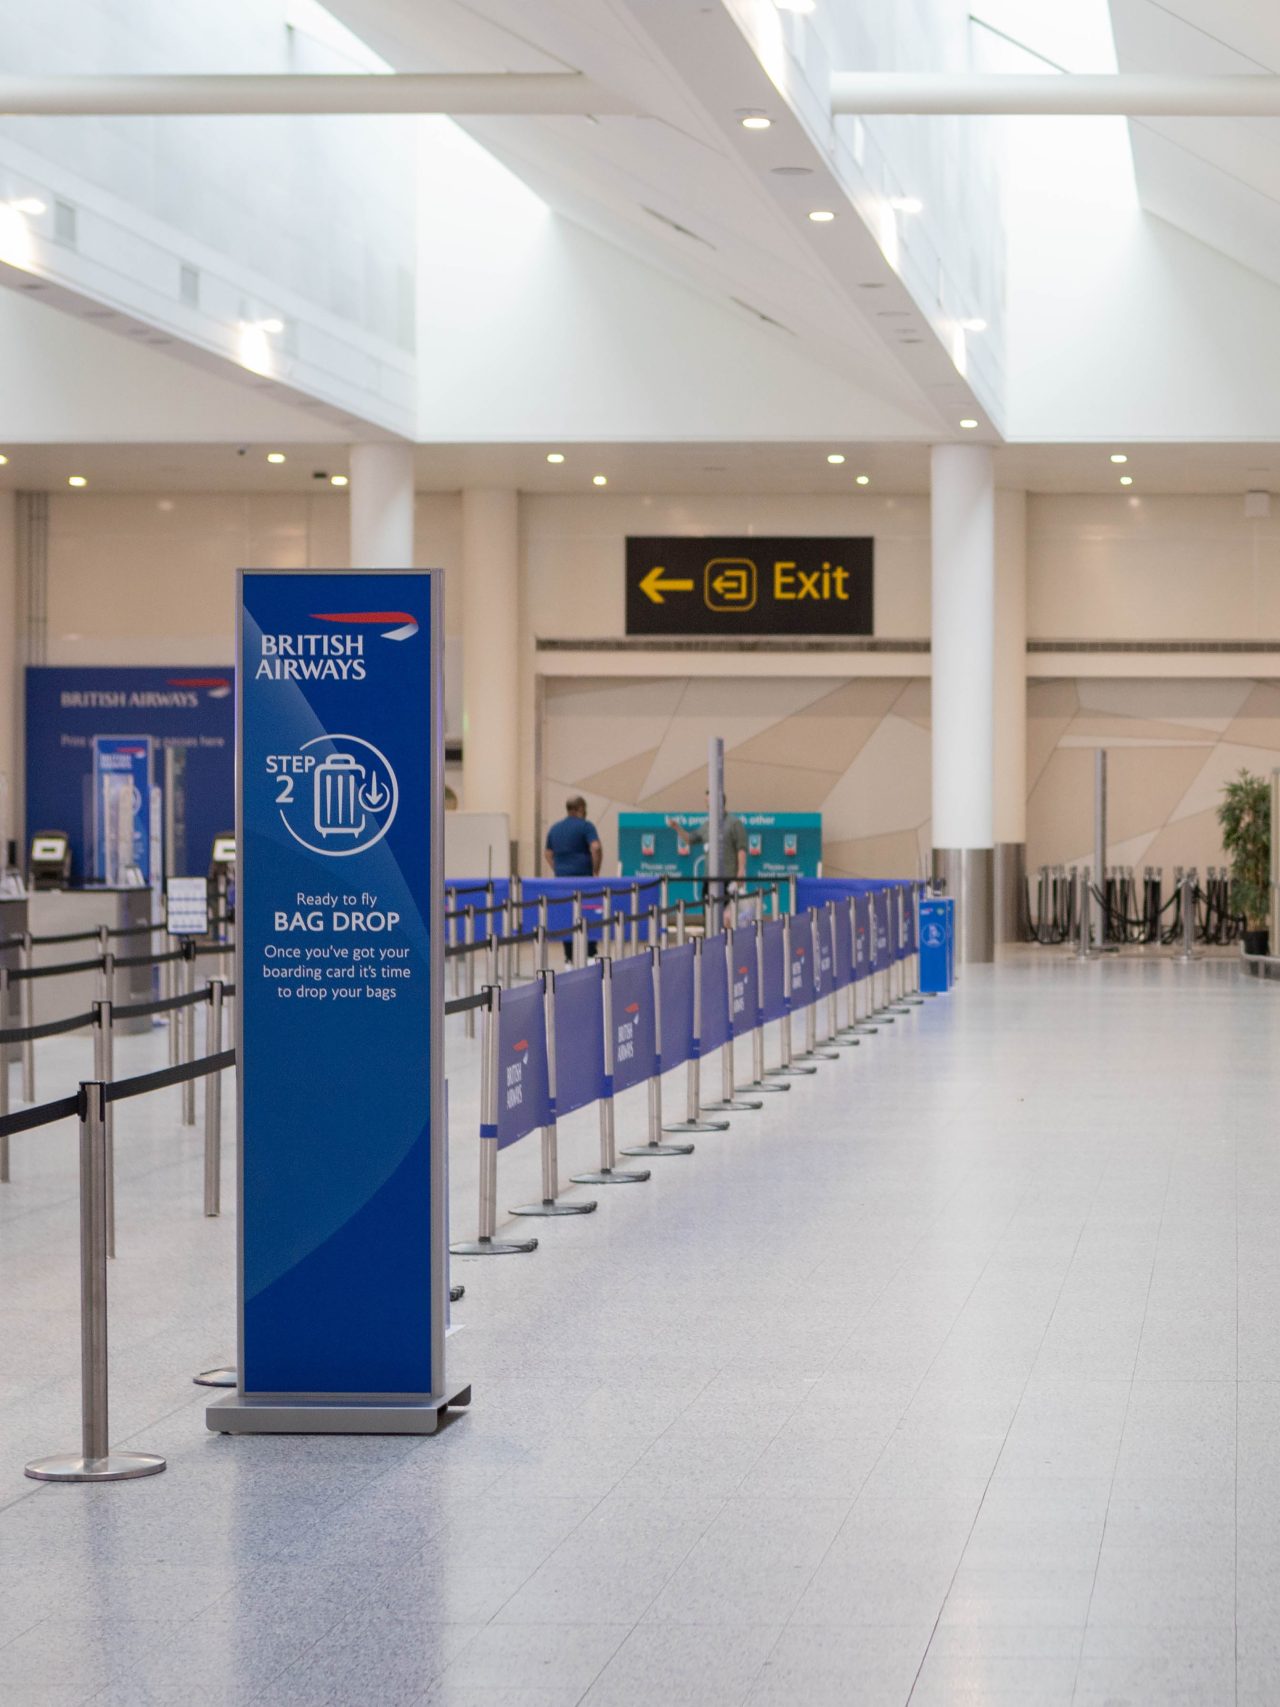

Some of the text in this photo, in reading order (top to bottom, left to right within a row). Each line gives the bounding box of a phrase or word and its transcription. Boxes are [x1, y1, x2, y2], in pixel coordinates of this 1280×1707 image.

[774, 561, 849, 600] Exit
[261, 634, 364, 656] BRITISH
[255, 658, 367, 681] AIRWAYS
[60, 691, 199, 708] BRITISH AIRWAYS
[265, 755, 316, 774] STEP
[275, 774, 295, 803] 2
[750, 815, 776, 826] other
[296, 892, 377, 908] Ready to fly
[274, 911, 400, 932] BAG DROP
[264, 944, 410, 961] Once you've got your
[263, 964, 411, 980] boarding card it's time
[277, 984, 397, 1000] to drop your bags
[617, 1022, 633, 1043] BRITISH
[506, 1062, 522, 1087] BRITISH
[506, 1083, 523, 1110] AIRWAYS
